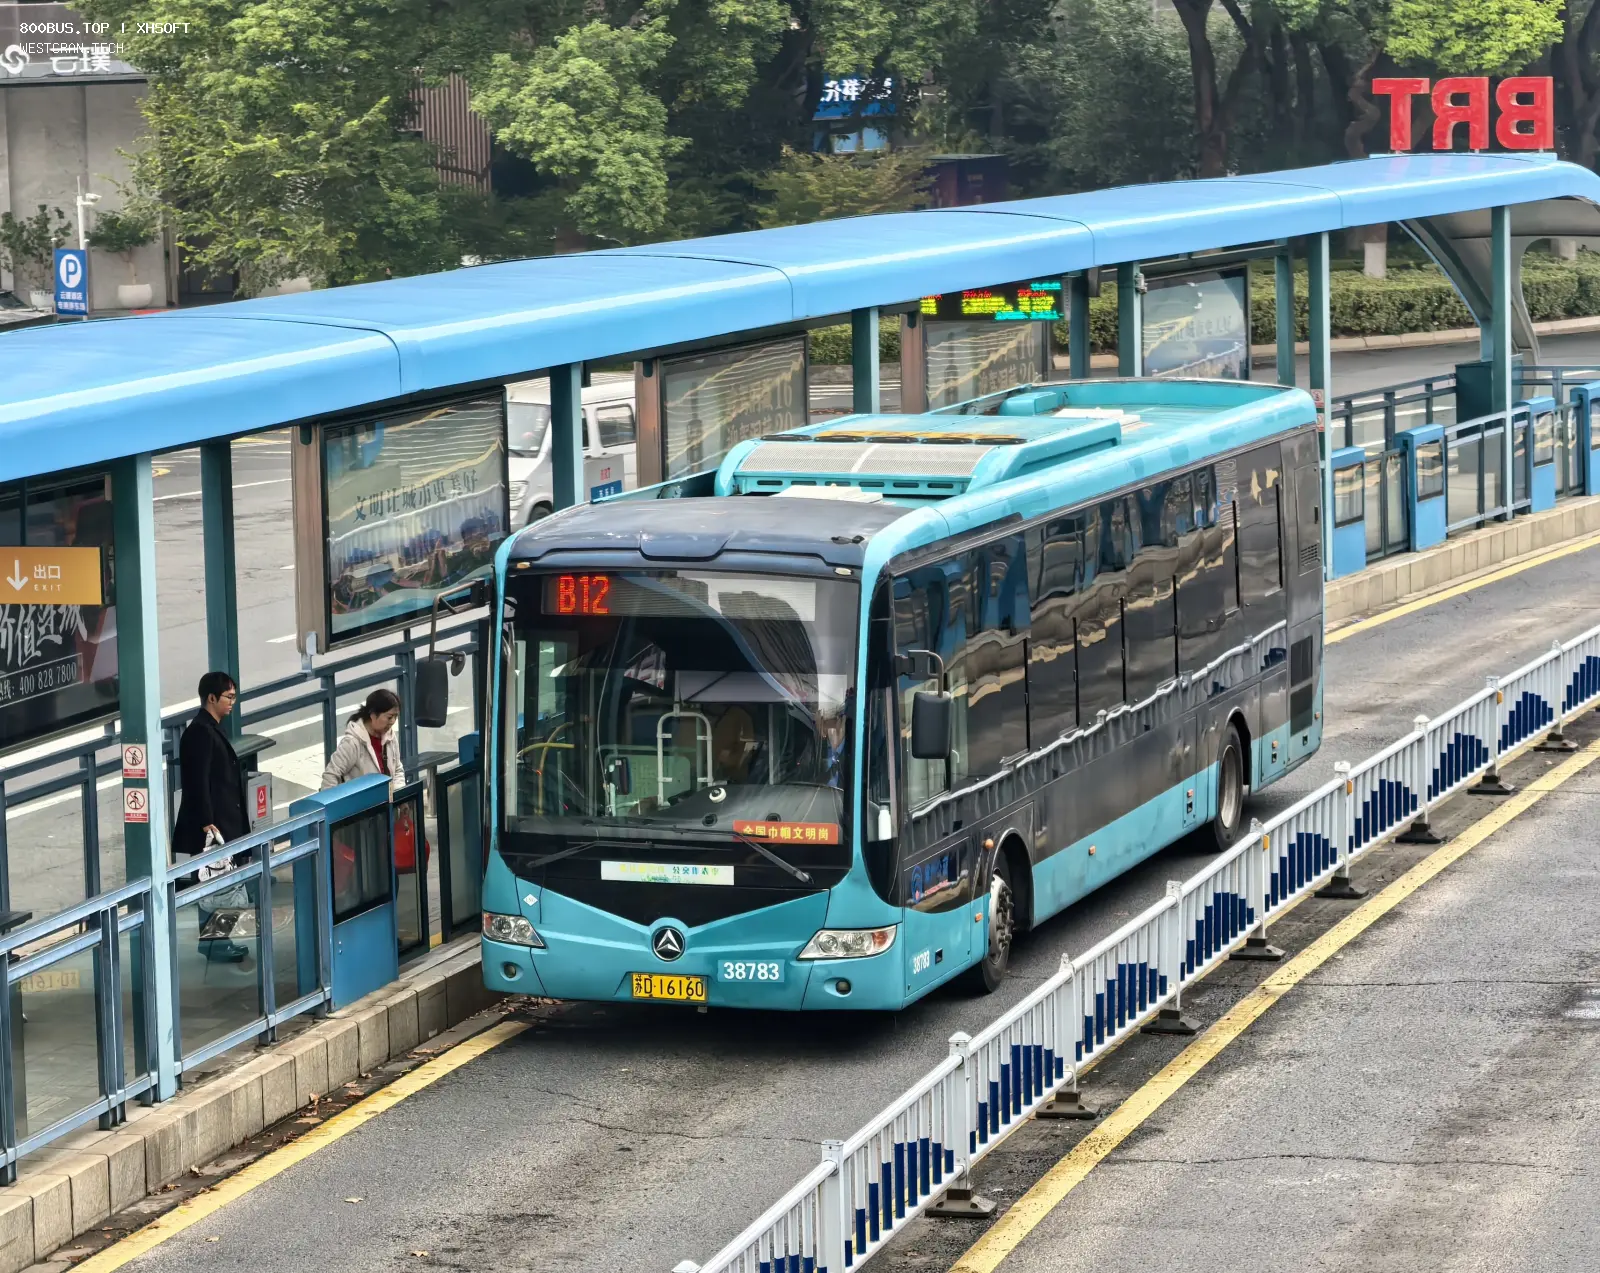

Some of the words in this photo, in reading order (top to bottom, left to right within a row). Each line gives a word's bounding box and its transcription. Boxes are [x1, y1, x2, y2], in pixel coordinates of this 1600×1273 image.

[65, 258, 78, 284] P
[33, 564, 61, 580] 出口
[33, 583, 62, 592] EXIT
[558, 575, 610, 615] B12
[19, 674, 35, 696] 400
[38, 668, 54, 690] 828
[56, 661, 77, 684] 7800
[743, 825, 829, 841] 全国巾帼文明岗
[723, 961, 780, 981] 38783
